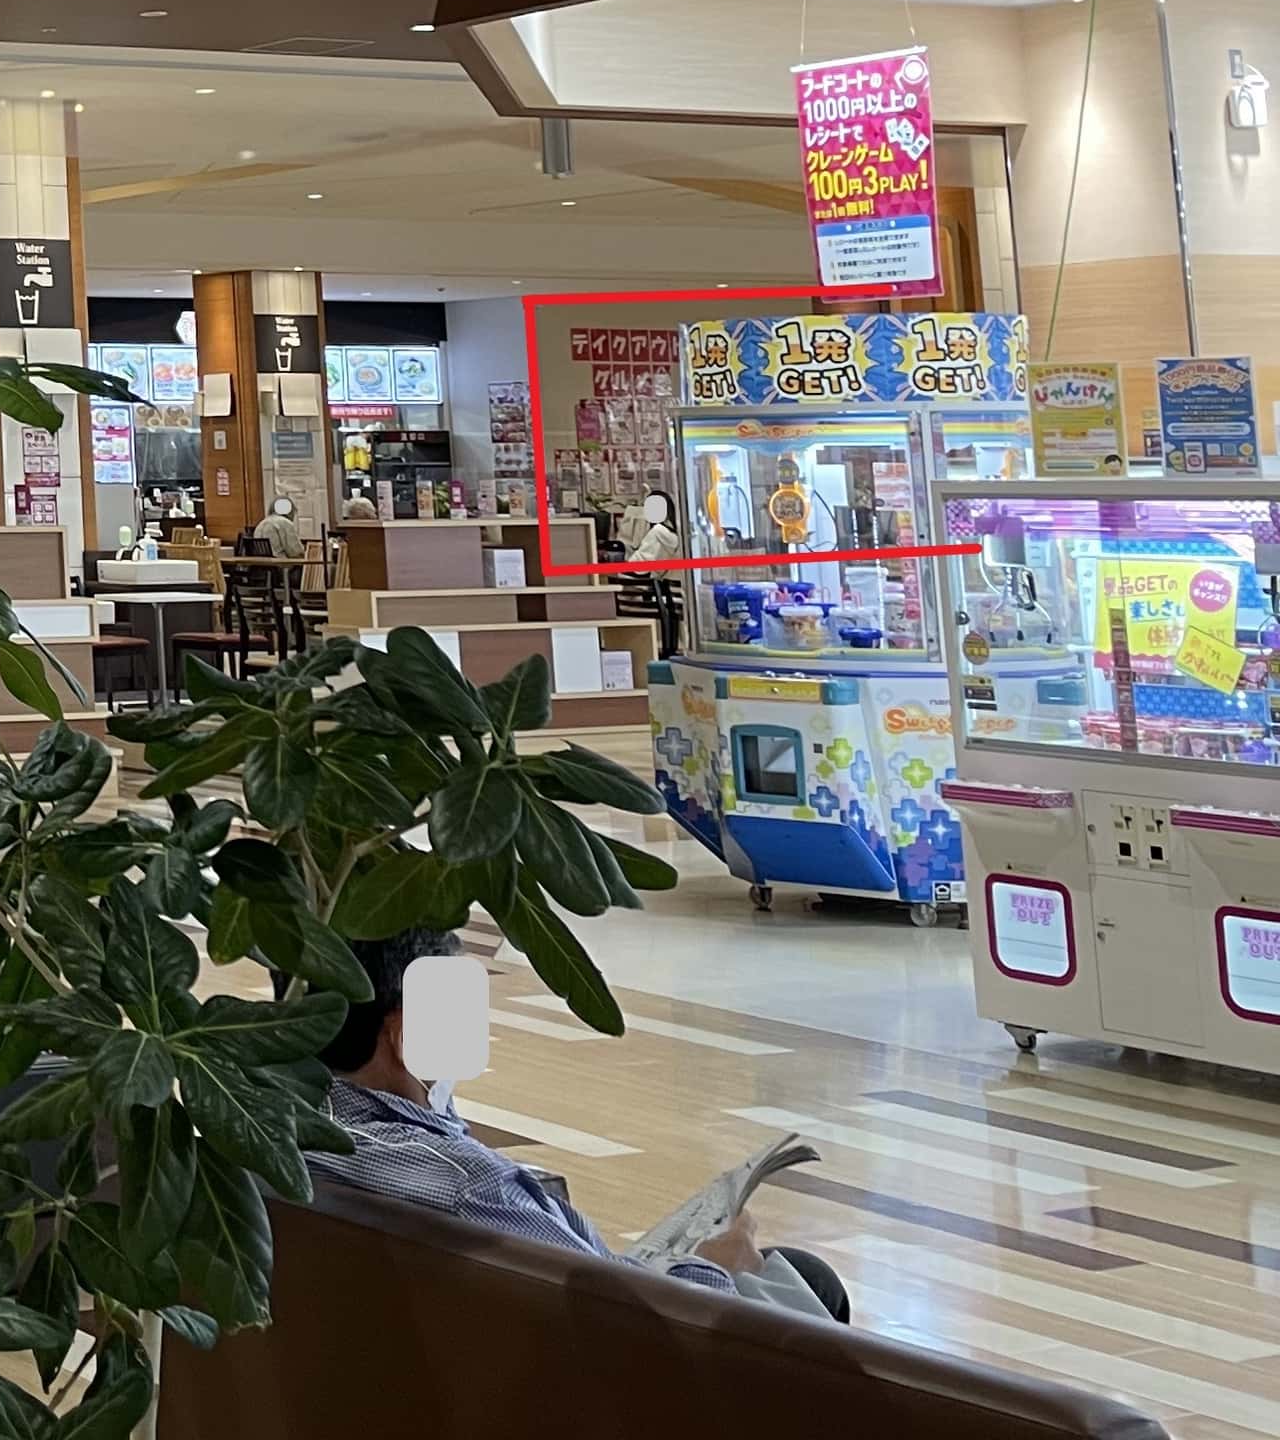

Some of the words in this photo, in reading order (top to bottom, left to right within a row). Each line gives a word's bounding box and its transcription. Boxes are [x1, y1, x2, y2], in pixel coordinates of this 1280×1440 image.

[801, 72, 882, 98] フードコートの
[803, 90, 917, 124] 1000円以上の
[805, 123, 864, 148] レシートで
[806, 142, 894, 172] クレーンゲーム
[809, 159, 928, 201] 100円3PLAY!
[14, 242, 45, 253] Water
[16, 254, 50, 265] Station
[690, 327, 729, 368] 1発
[775, 321, 852, 365] 1発
[911, 318, 978, 362] 1発
[692, 368, 737, 399] GET!
[777, 364, 861, 396] GET!
[912, 363, 987, 393] GET!
[1010, 893, 1056, 914] PRIZE
[1016, 908, 1053, 927] OUT
